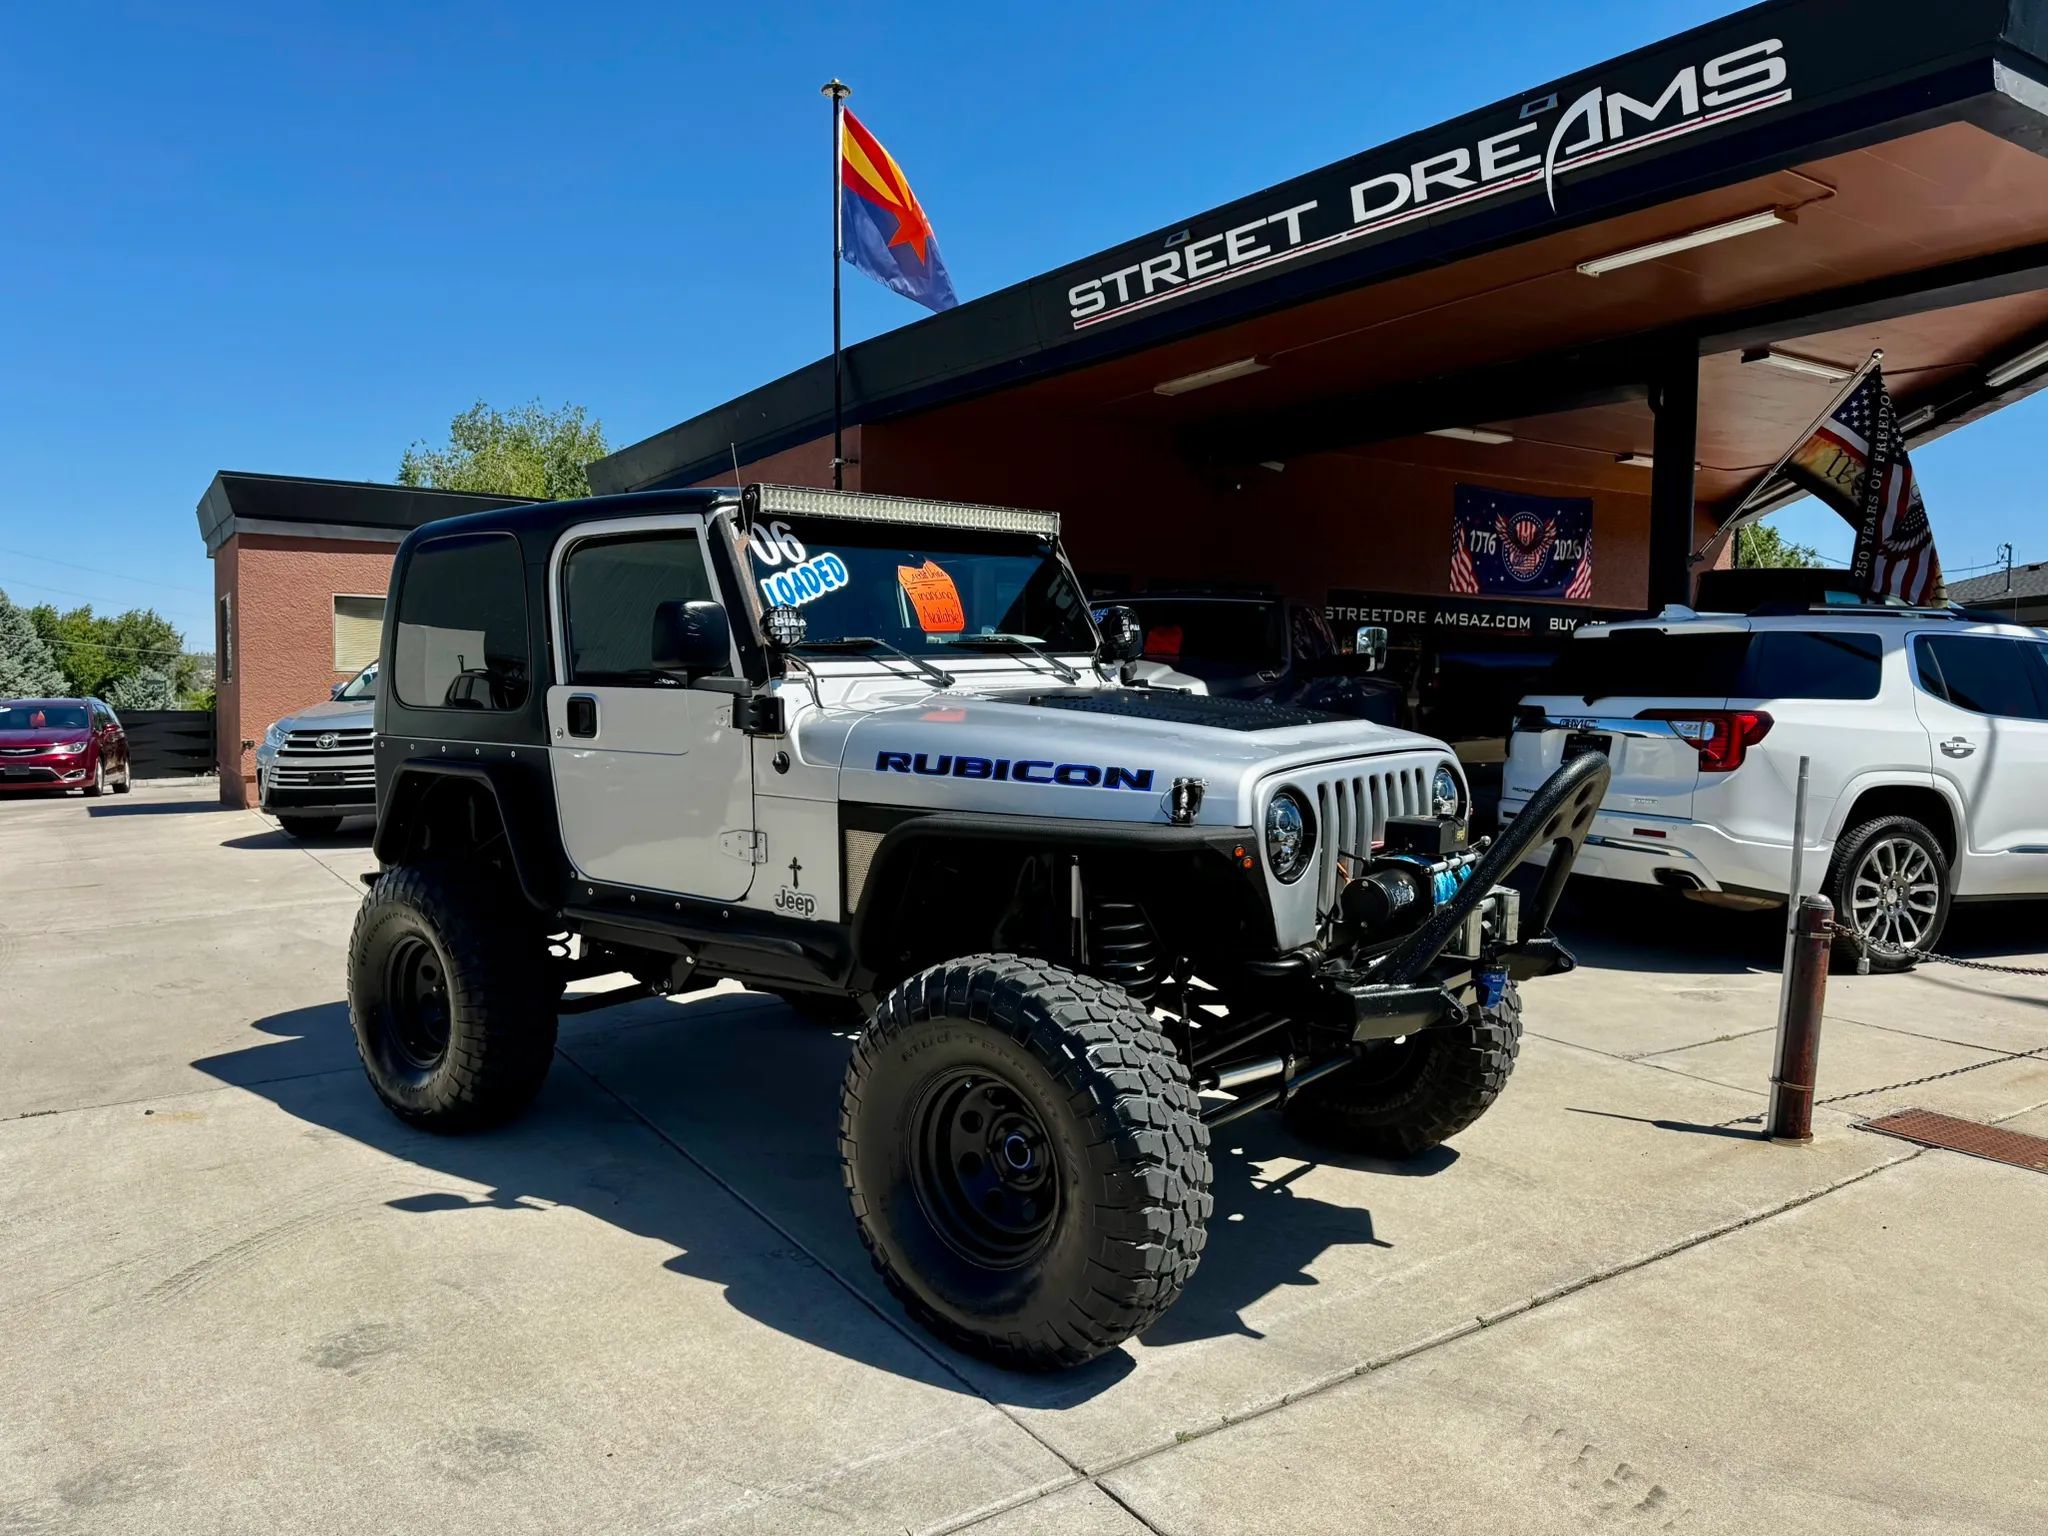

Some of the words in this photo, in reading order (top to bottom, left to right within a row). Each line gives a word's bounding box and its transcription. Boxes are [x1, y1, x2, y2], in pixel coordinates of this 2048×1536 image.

[1068, 201, 1318, 318] STREET
[1350, 38, 1788, 223] DREAMS
[1870, 467, 1883, 490] OF
[1860, 495, 1879, 545] YEARS
[1469, 529, 1498, 556] 1776
[1552, 538, 1582, 561] 2026
[1854, 550, 1870, 578] 250
[762, 553, 847, 608] LOADED
[1325, 606, 1427, 624] STREETDRE
[1433, 611, 1531, 630] AMSAZ.COM
[1549, 616, 1578, 632] BUY
[1560, 718, 1600, 729] GMC
[875, 750, 1155, 792] RUBICON
[775, 888, 815, 917] Jeep
